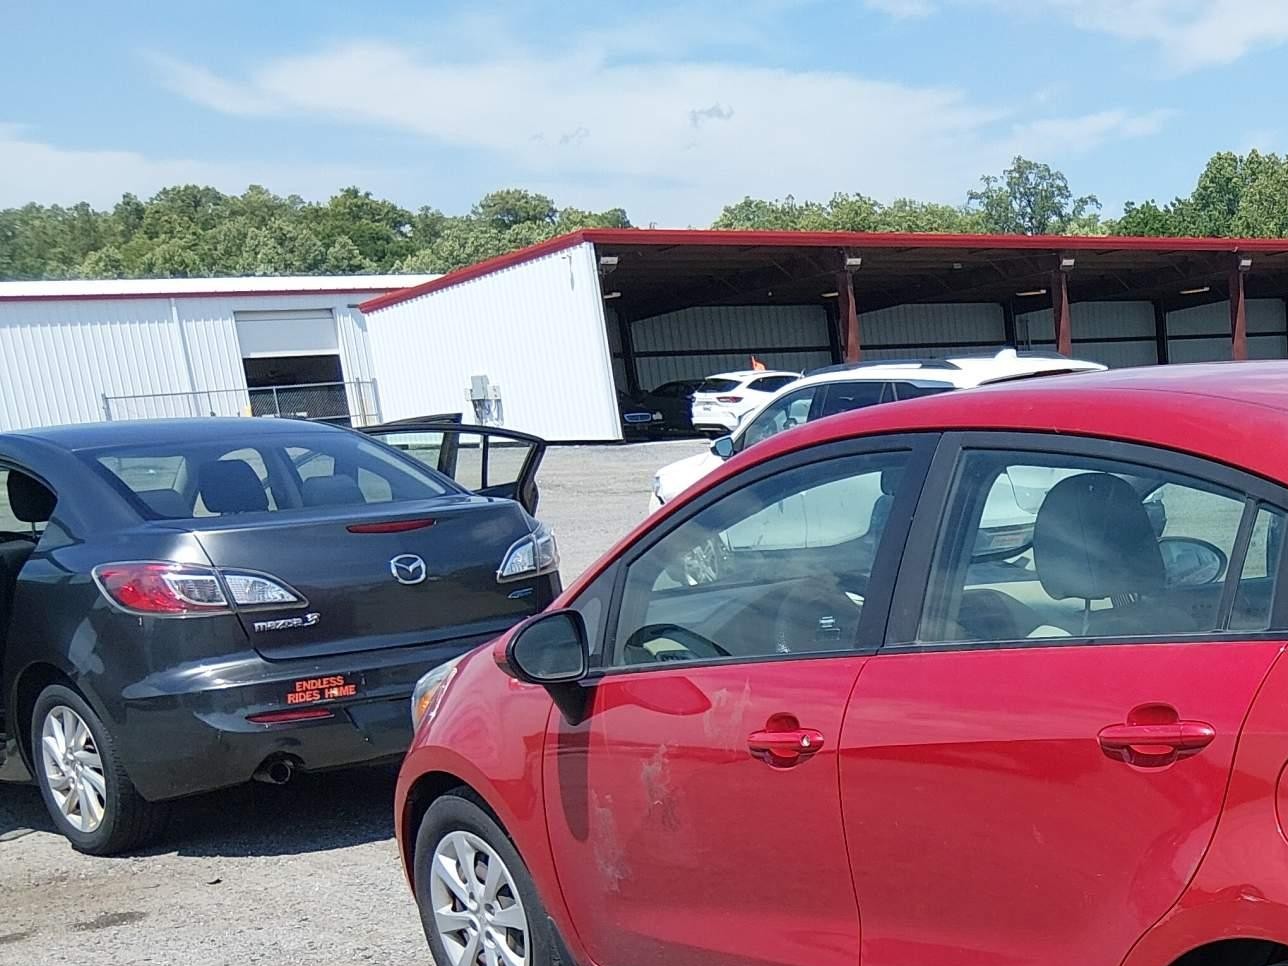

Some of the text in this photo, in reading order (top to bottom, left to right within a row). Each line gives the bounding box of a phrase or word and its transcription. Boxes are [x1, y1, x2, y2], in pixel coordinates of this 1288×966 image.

[295, 676, 345, 692] ENDLESS
[287, 685, 356, 705] RIDES HME
